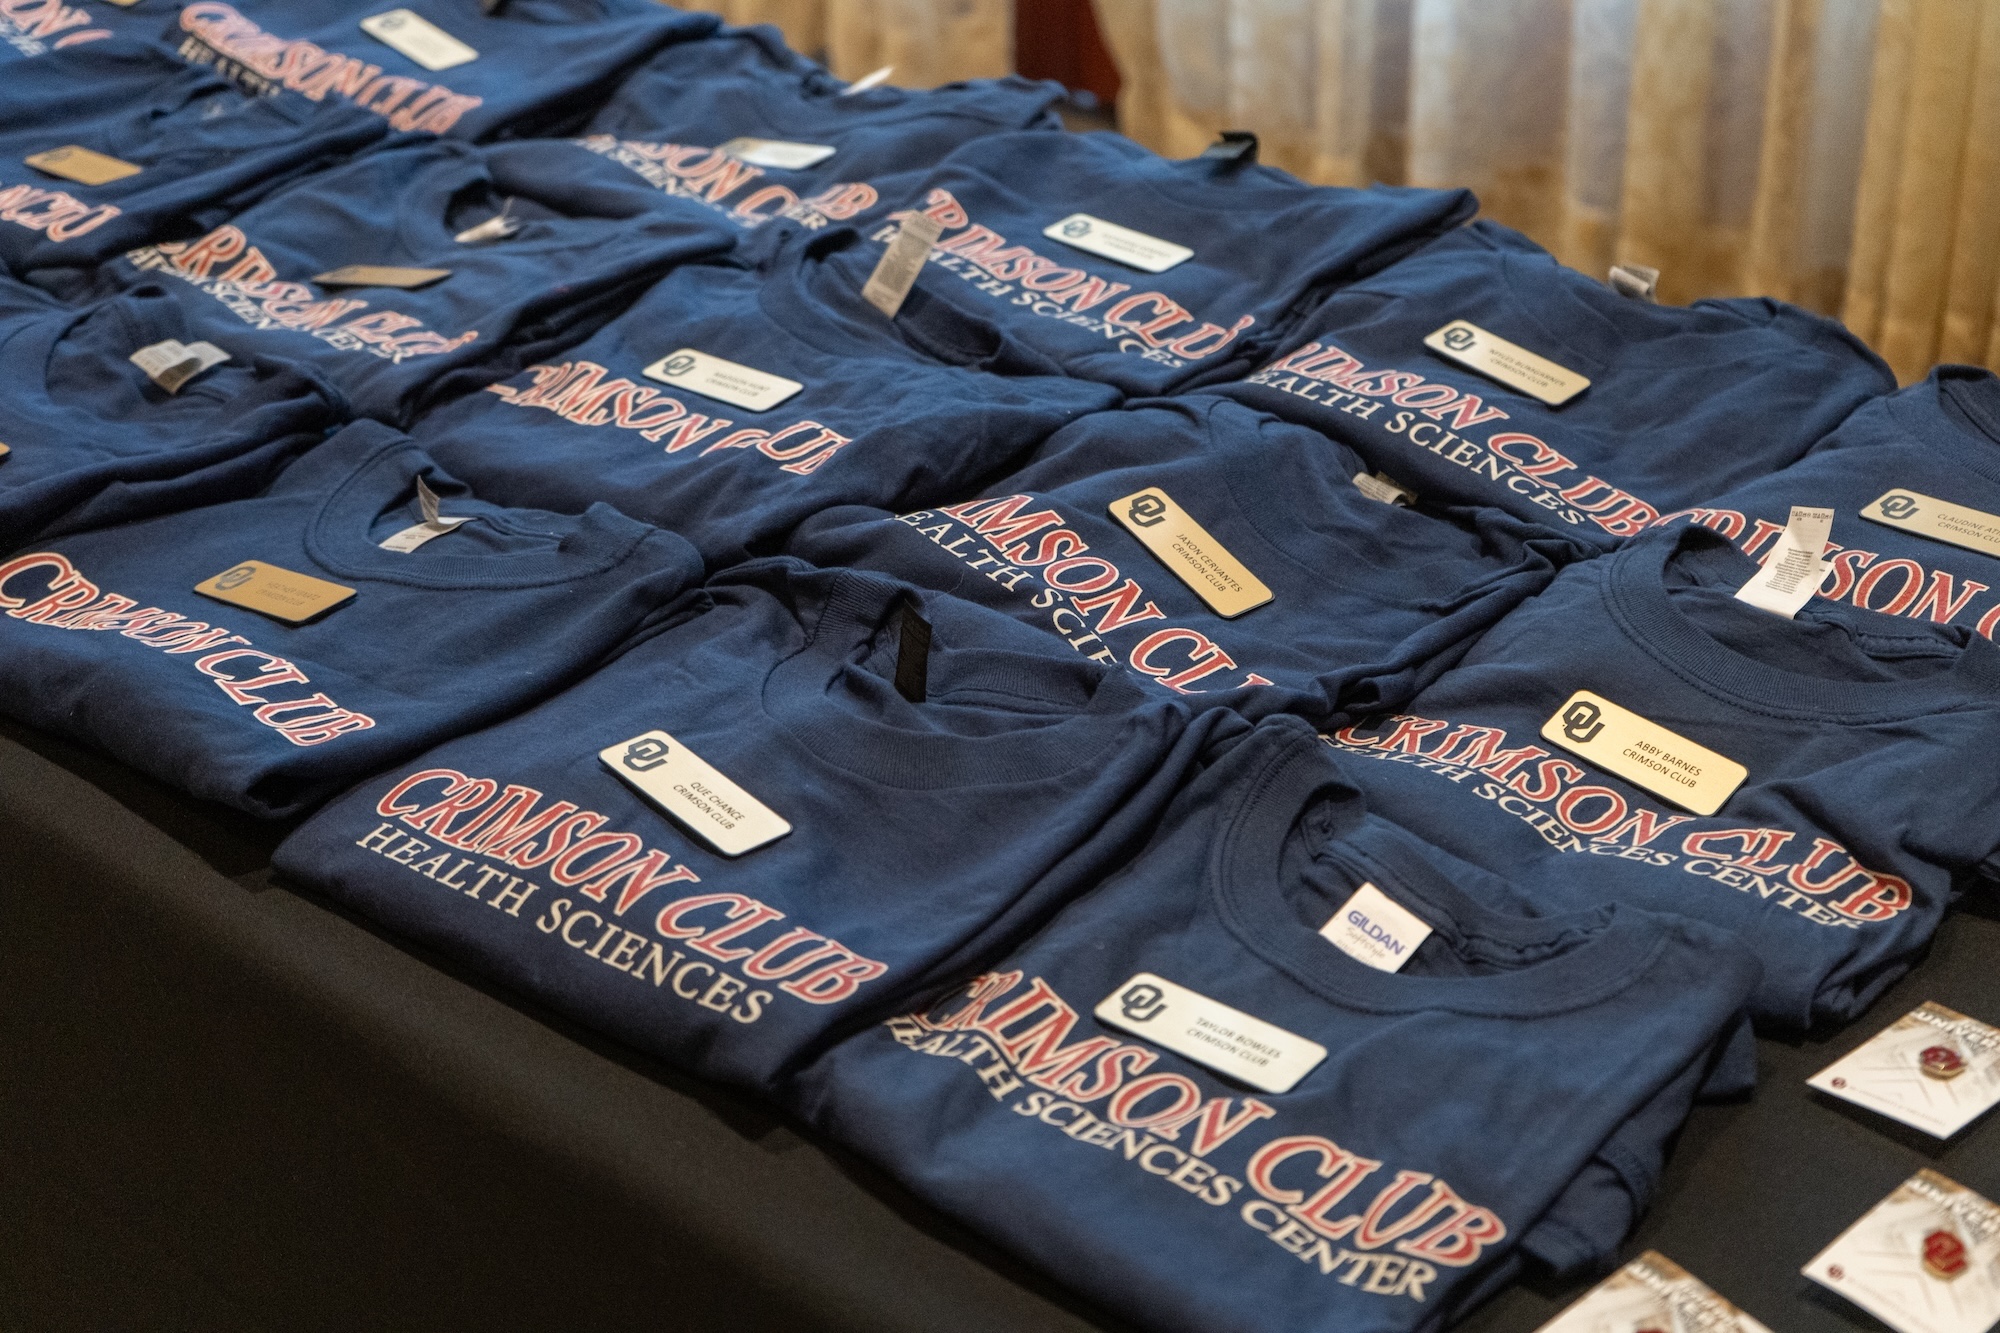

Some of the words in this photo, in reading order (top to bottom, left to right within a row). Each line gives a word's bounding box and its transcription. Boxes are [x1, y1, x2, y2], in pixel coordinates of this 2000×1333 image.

[888, 188, 1132, 312] RIMSON
[1104, 291, 1255, 360] CLU
[1443, 327, 1478, 352] OU
[663, 355, 697, 378] OU
[1489, 356, 1527, 379] CRIMSON
[1244, 371, 1386, 421] EALTH
[1384, 411, 1587, 527] SCIENCES
[1487, 431, 1662, 538] CLUB
[1879, 495, 1920, 520] OU
[1128, 493, 1167, 528] OU
[1937, 513, 1984, 531] CLAUDINE
[1937, 521, 1983, 539] CRIMSON
[894, 510, 1034, 592] EALTH
[1171, 542, 1207, 576] CRIMSON
[1205, 573, 1227, 593] CLUB
[1175, 533, 1203, 557] JAXON
[1200, 552, 1243, 594] CERVANTES
[1128, 627, 1275, 696] CL
[194, 648, 376, 747] CLUB
[1562, 700, 1606, 744] OU
[622, 737, 670, 773] OU
[1622, 747, 1670, 777] CRIMSON
[1669, 771, 1698, 789] CLUB
[1634, 739, 1663, 758] ABBY
[1661, 752, 1703, 778] BARNES
[672, 783, 714, 816] CRIMSON
[710, 811, 736, 831] CLUB
[690, 780, 712, 798] QUE
[708, 794, 746, 822] CHANCE
[1472, 782, 1680, 867] SCIENCES
[375, 767, 703, 918] CRIMSON
[656, 892, 889, 1006] CLUB
[1681, 828, 1913, 922] CLUB
[355, 821, 541, 918] HEALTH
[535, 897, 774, 1025] SCIENCES
[1347, 909, 1406, 956] GILDAN
[1120, 983, 1168, 1023] OU
[1185, 1026, 1238, 1056] CRIMSON
[1238, 1050, 1271, 1068] CLUB
[1196, 1016, 1235, 1039] TAYLOR
[1236, 1033, 1282, 1060] BOWLES
[1013, 1086, 1245, 1207] SCIENCES
[1240, 1199, 1439, 1302] CENTER
[1246, 1133, 1509, 1269] CLUB
